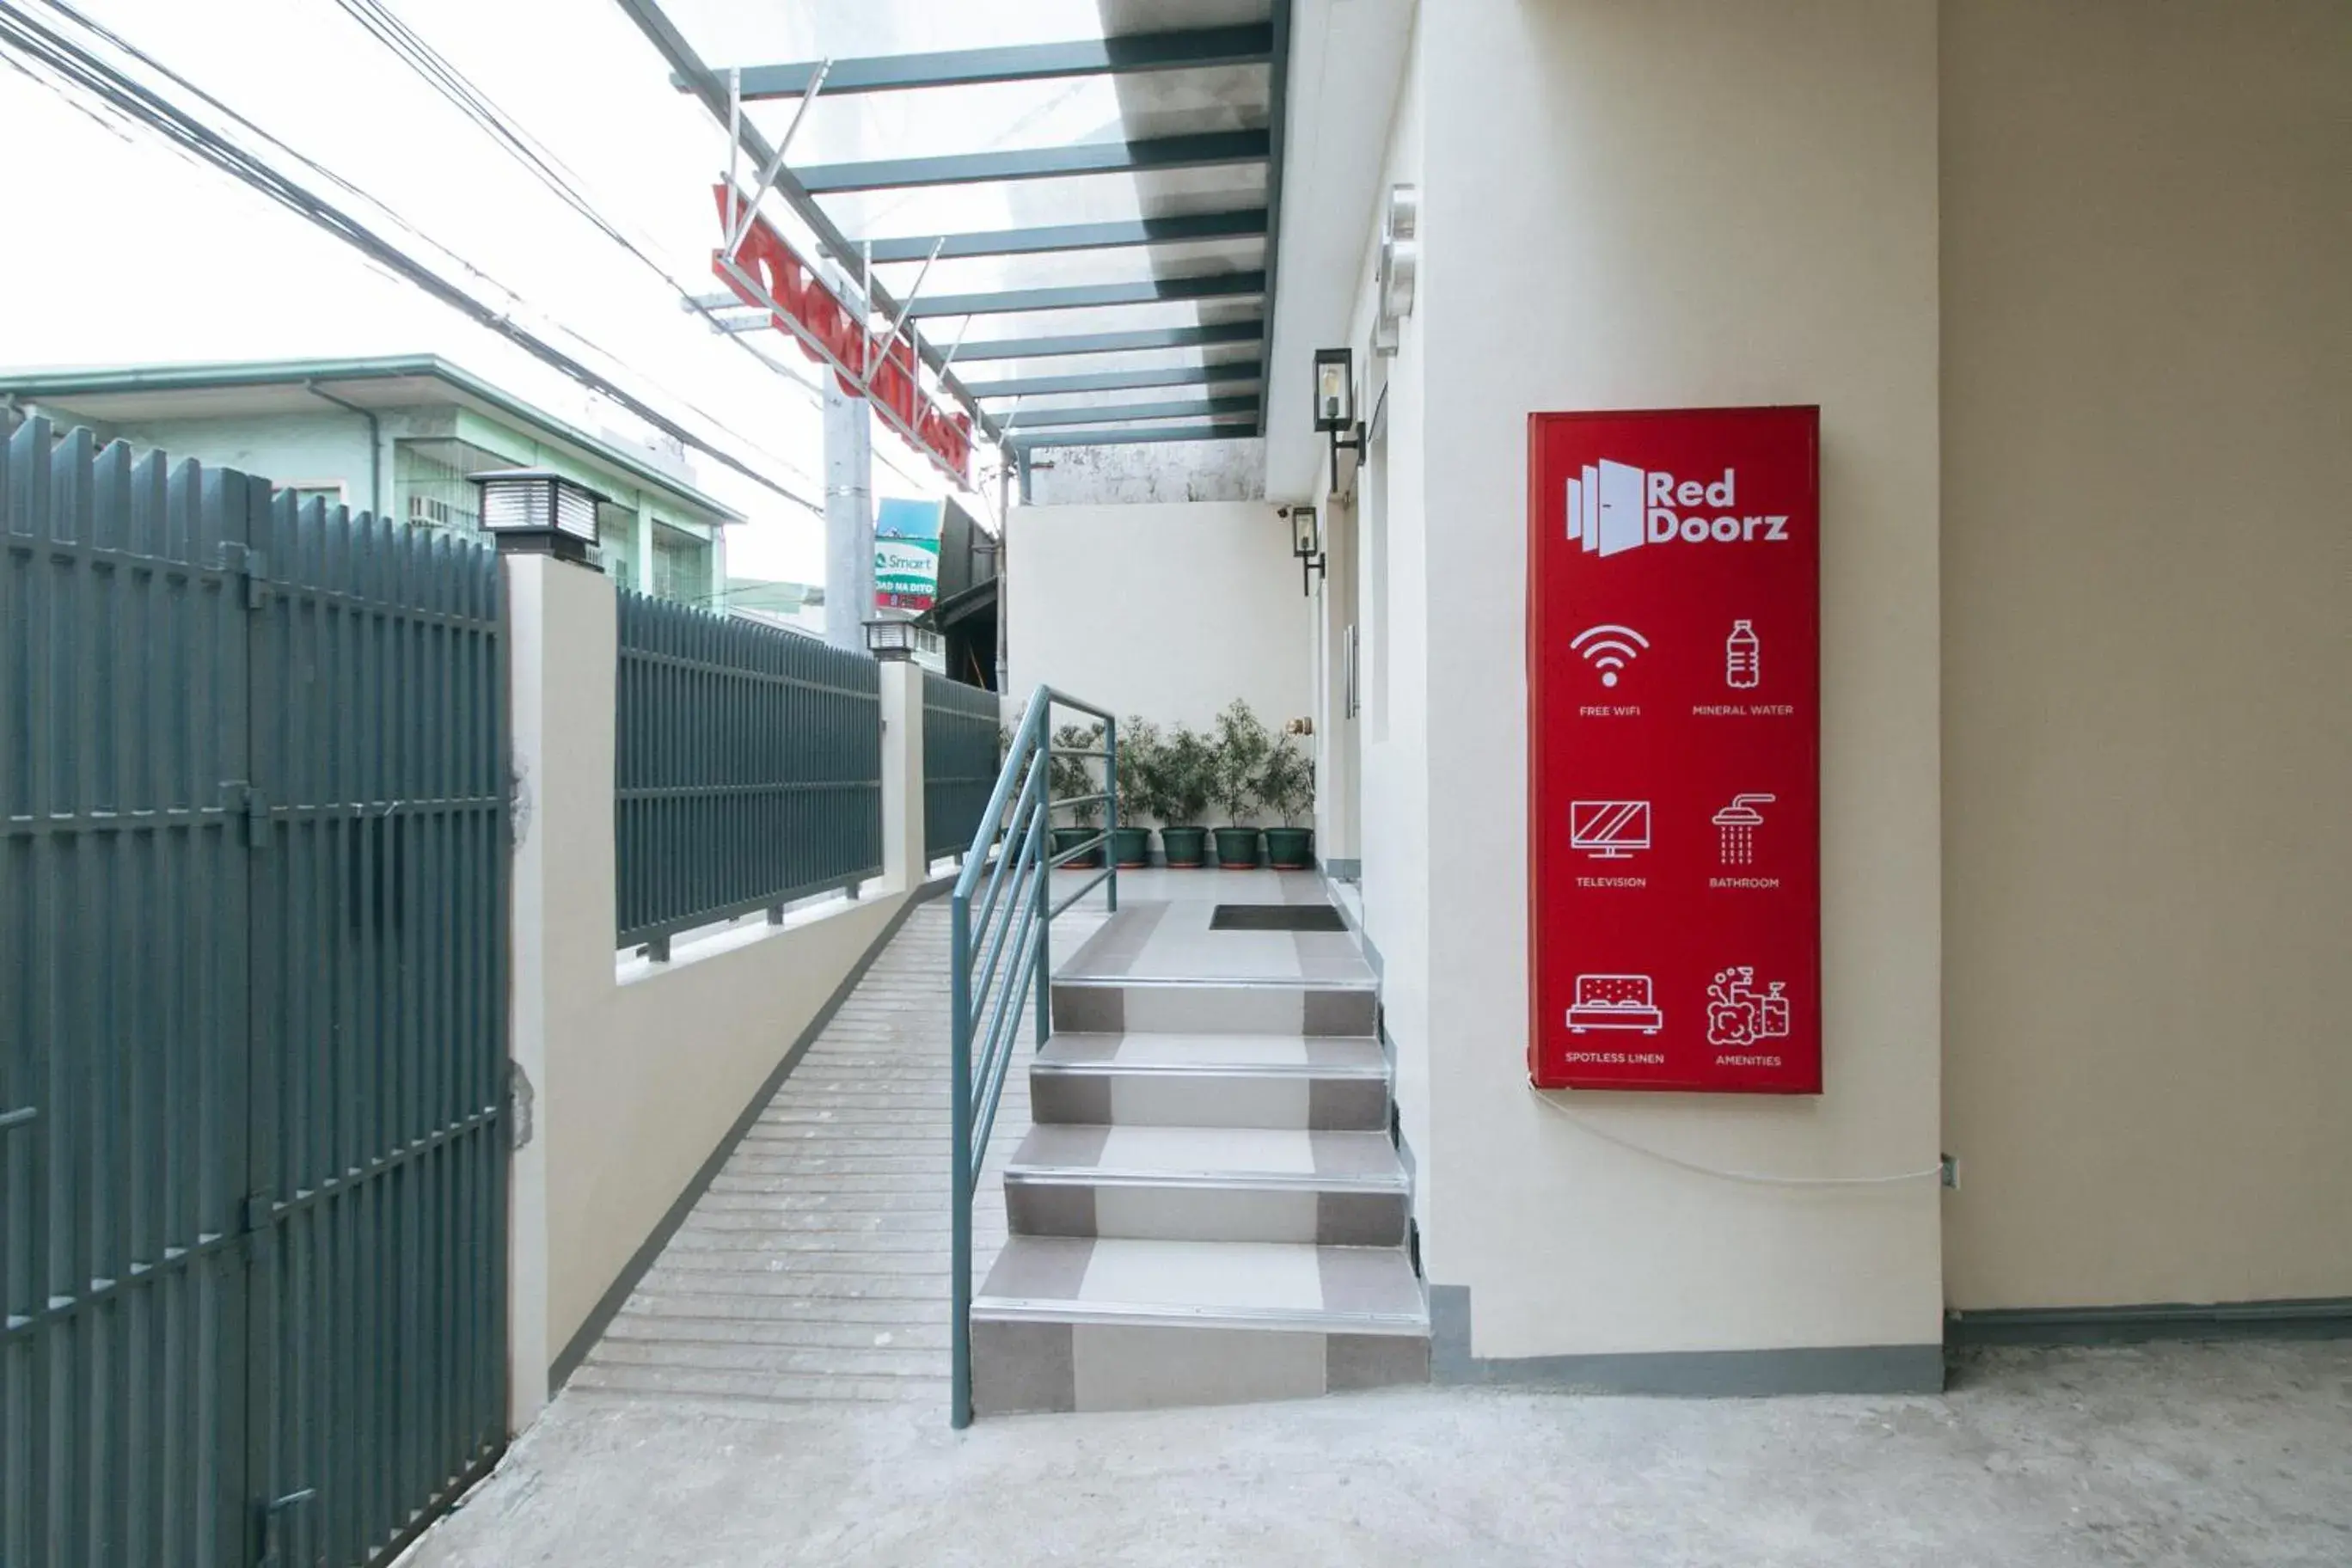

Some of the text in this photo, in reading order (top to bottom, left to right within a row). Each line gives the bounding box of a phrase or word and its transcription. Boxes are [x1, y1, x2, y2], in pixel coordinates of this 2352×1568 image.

[1647, 469, 1735, 507] Red
[1647, 507, 1789, 543] Doorz
[889, 554, 931, 569] Smart
[1580, 706, 1640, 716] FREE WIFI
[1693, 705, 1794, 715] MINERAL WATER
[1577, 877, 1646, 888] TELEVISION
[1709, 878, 1779, 888] BATHROOM
[1565, 1051, 1664, 1063] SPOTLESS LINEN
[1716, 1055, 1782, 1067] AMENITIES
